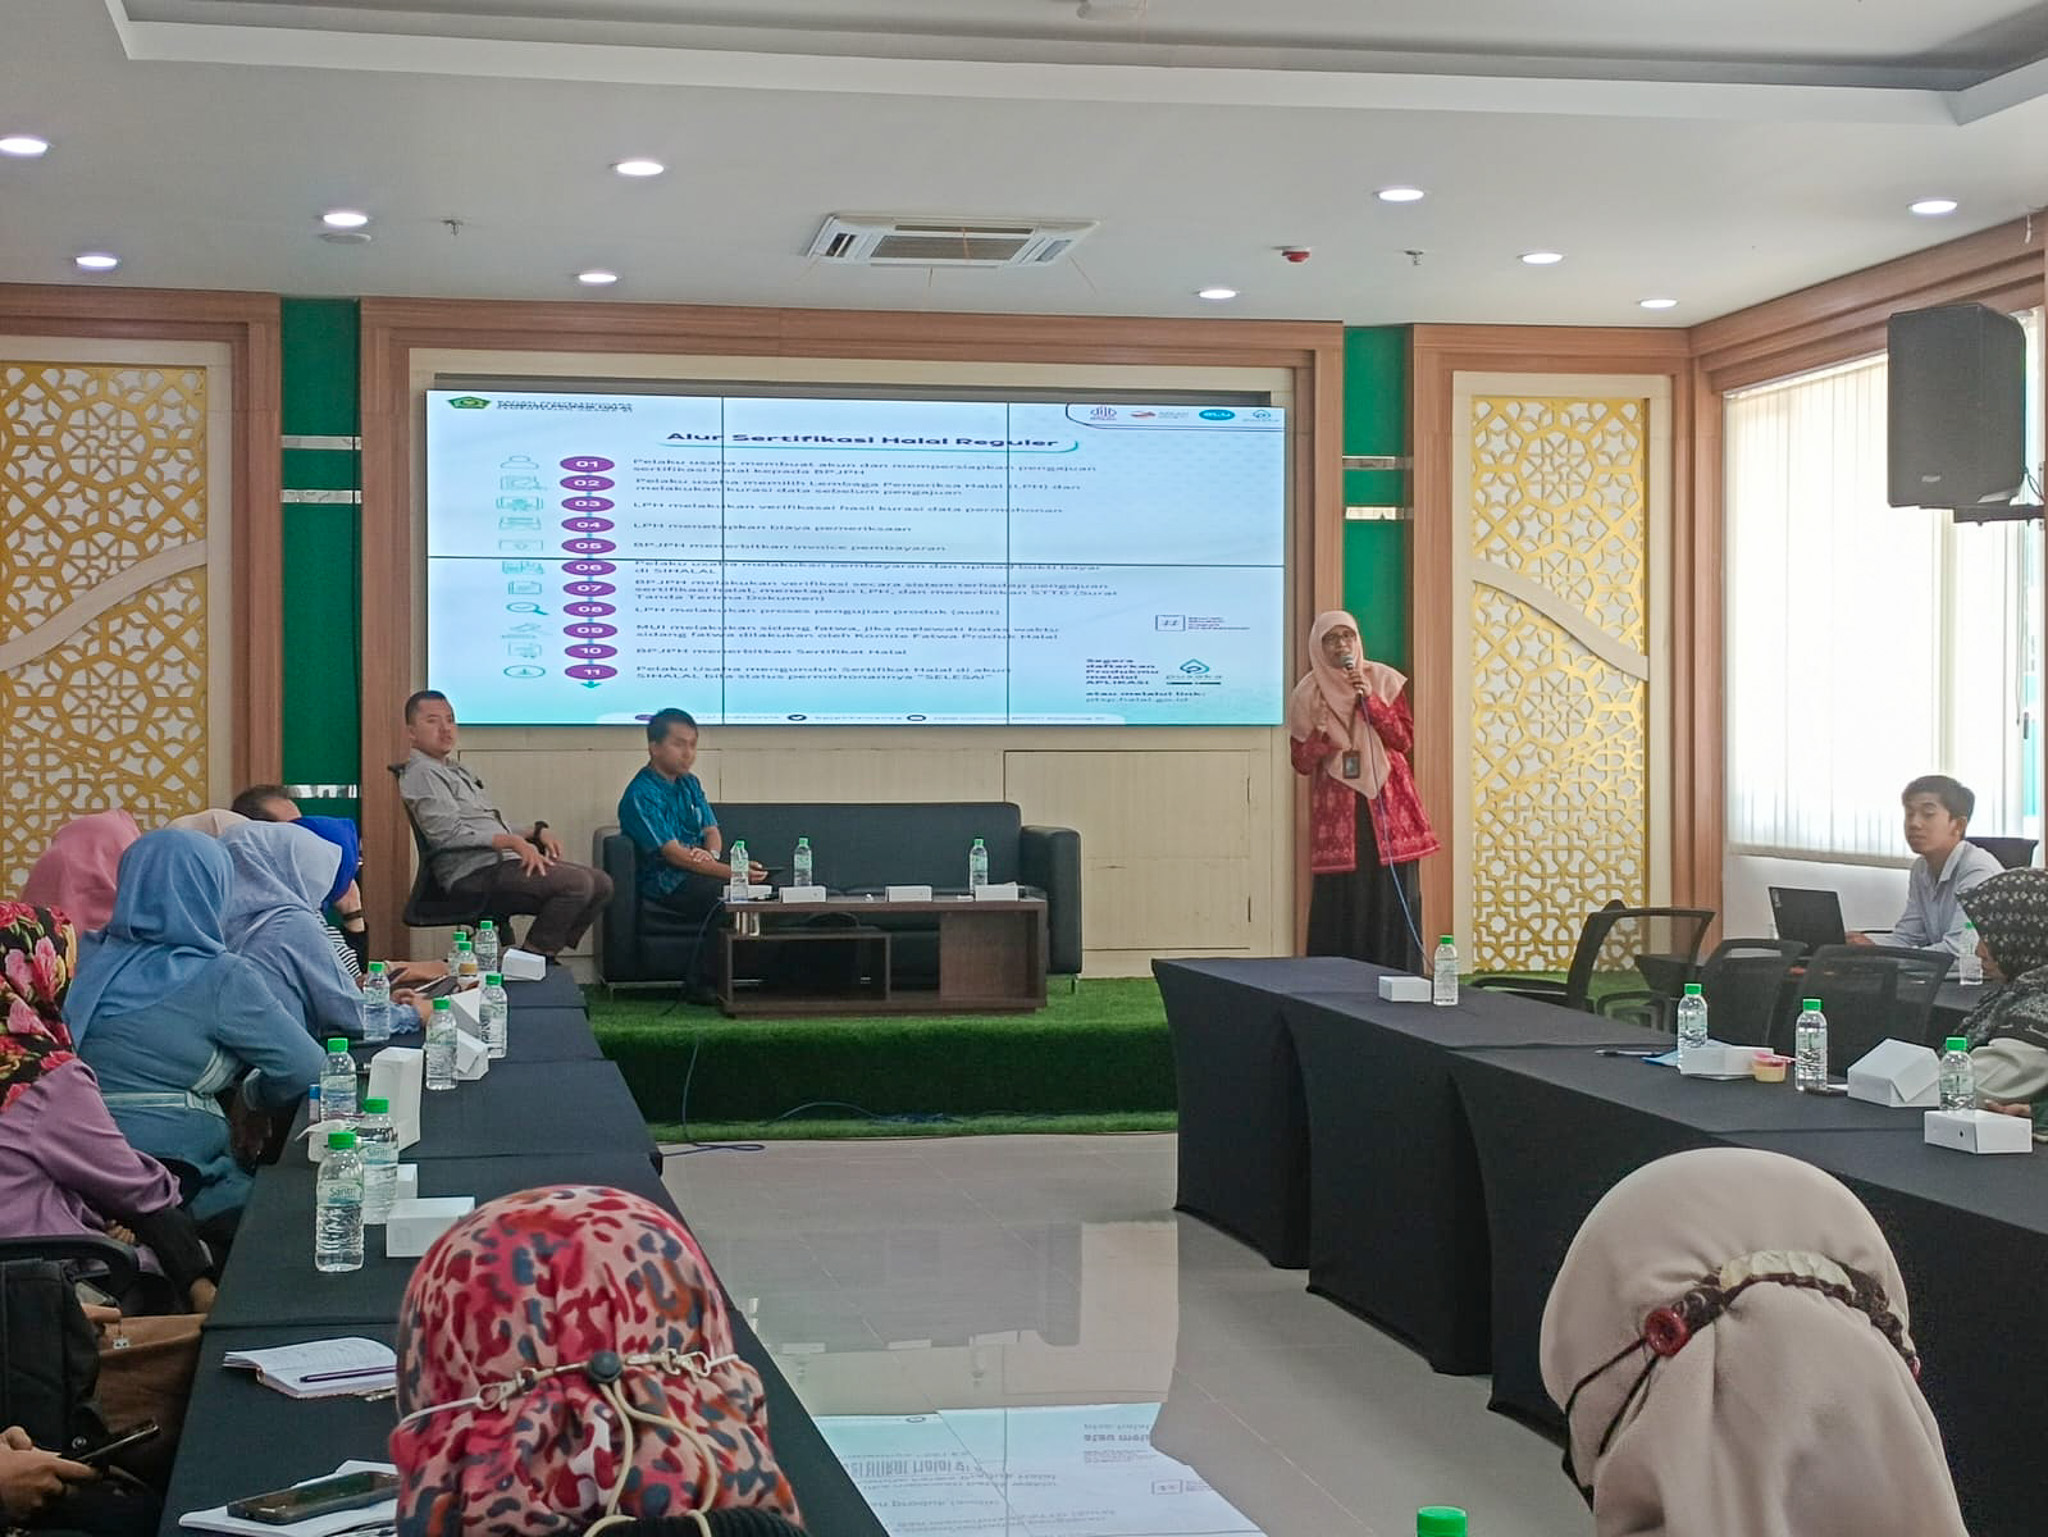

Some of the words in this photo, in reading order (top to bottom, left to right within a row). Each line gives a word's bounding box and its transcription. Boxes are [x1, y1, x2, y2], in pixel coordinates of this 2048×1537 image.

[667, 432, 723, 441] Alur
[732, 433, 874, 443] Sertifikasi
[882, 437, 948, 445] Halal
[956, 437, 1058, 447] Reguler
[575, 460, 599, 468] 01
[573, 479, 600, 487] 02
[575, 542, 603, 550] 05
[575, 563, 603, 571] 06
[576, 584, 603, 592] 07
[577, 605, 603, 613] 08
[576, 626, 604, 634] 09
[579, 646, 602, 654] 10
[583, 668, 601, 676] 11
